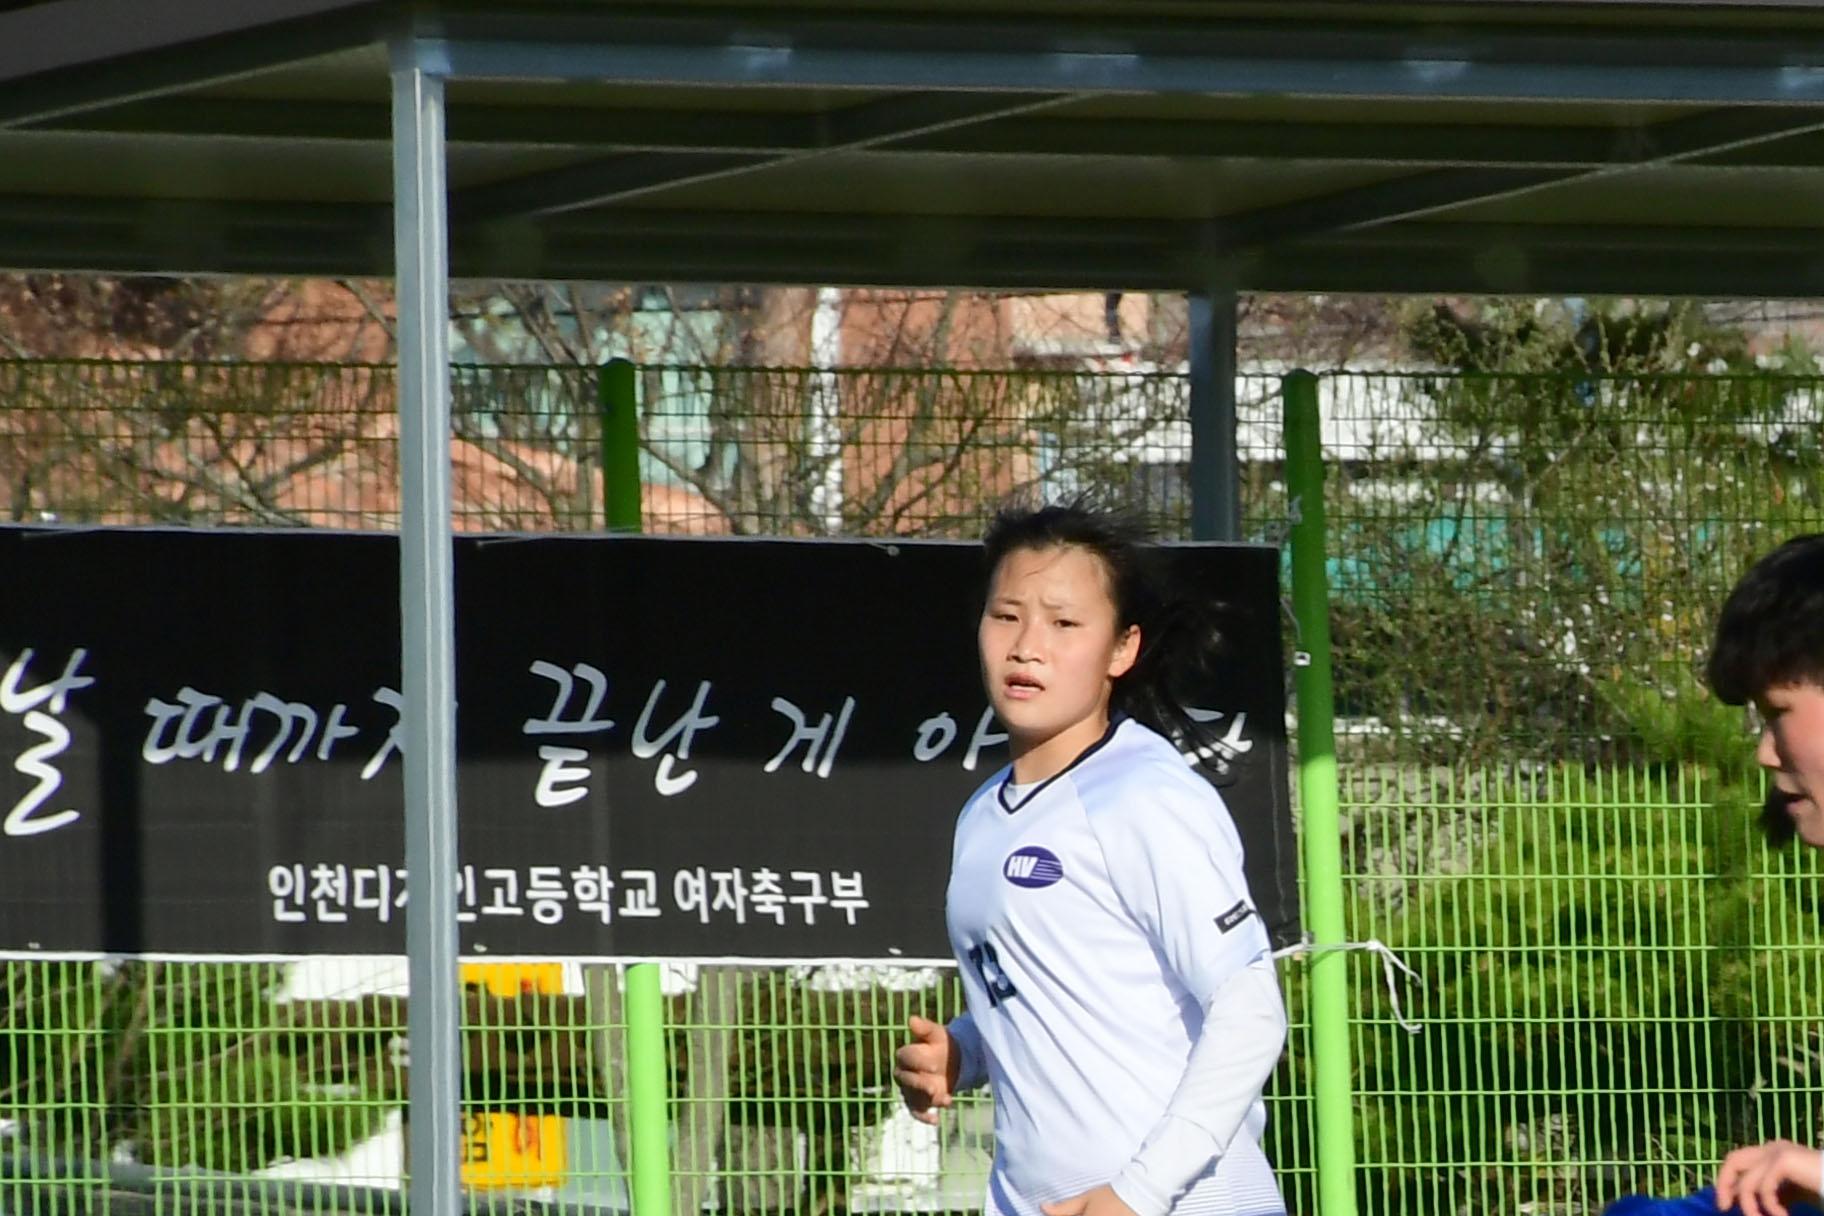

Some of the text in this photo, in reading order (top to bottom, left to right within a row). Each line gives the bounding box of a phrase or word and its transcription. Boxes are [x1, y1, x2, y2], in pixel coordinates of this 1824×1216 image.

[523, 660, 719, 807] 끝난
[763, 696, 855, 779] 게
[674, 866, 870, 925] 여자축구부
